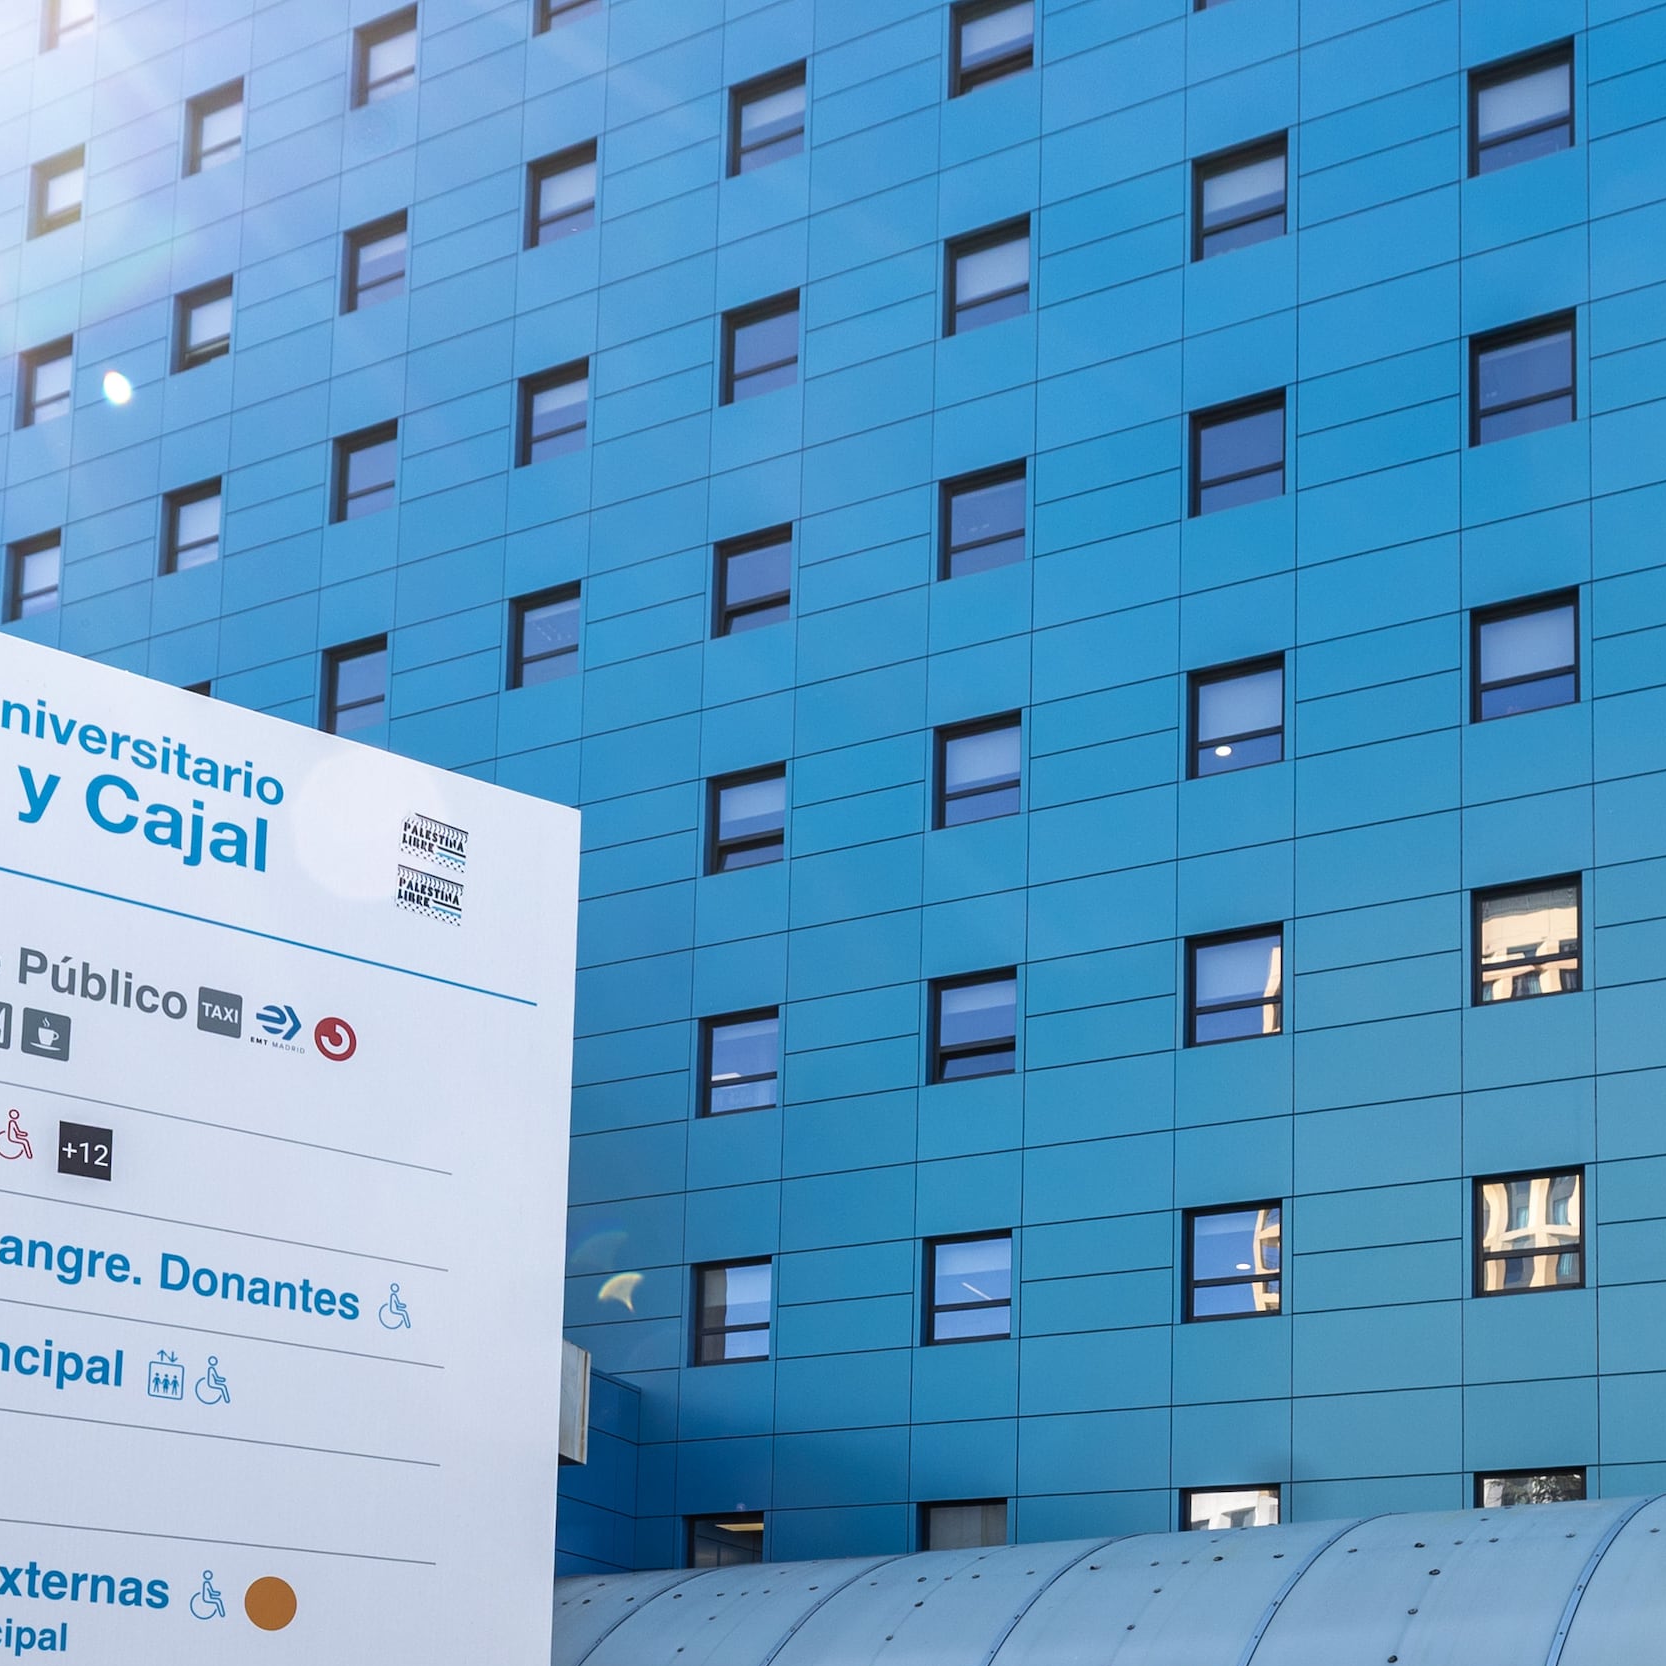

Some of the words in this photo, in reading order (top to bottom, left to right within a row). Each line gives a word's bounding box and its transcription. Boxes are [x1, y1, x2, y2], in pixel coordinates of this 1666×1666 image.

[18, 765, 61, 824] y
[85, 774, 268, 873] Cajal
[402, 832, 435, 854] LIBRE
[403, 821, 464, 853] PALESTINA
[397, 888, 430, 908] LIBRE
[399, 877, 460, 906] PALESTINA
[19, 947, 187, 1019] Público
[201, 1001, 239, 1024] TAXI
[250, 1036, 268, 1046] EMT
[272, 1041, 306, 1054] MADRID
[61, 1137, 109, 1167] +12
[160, 1252, 359, 1320] Donantes
